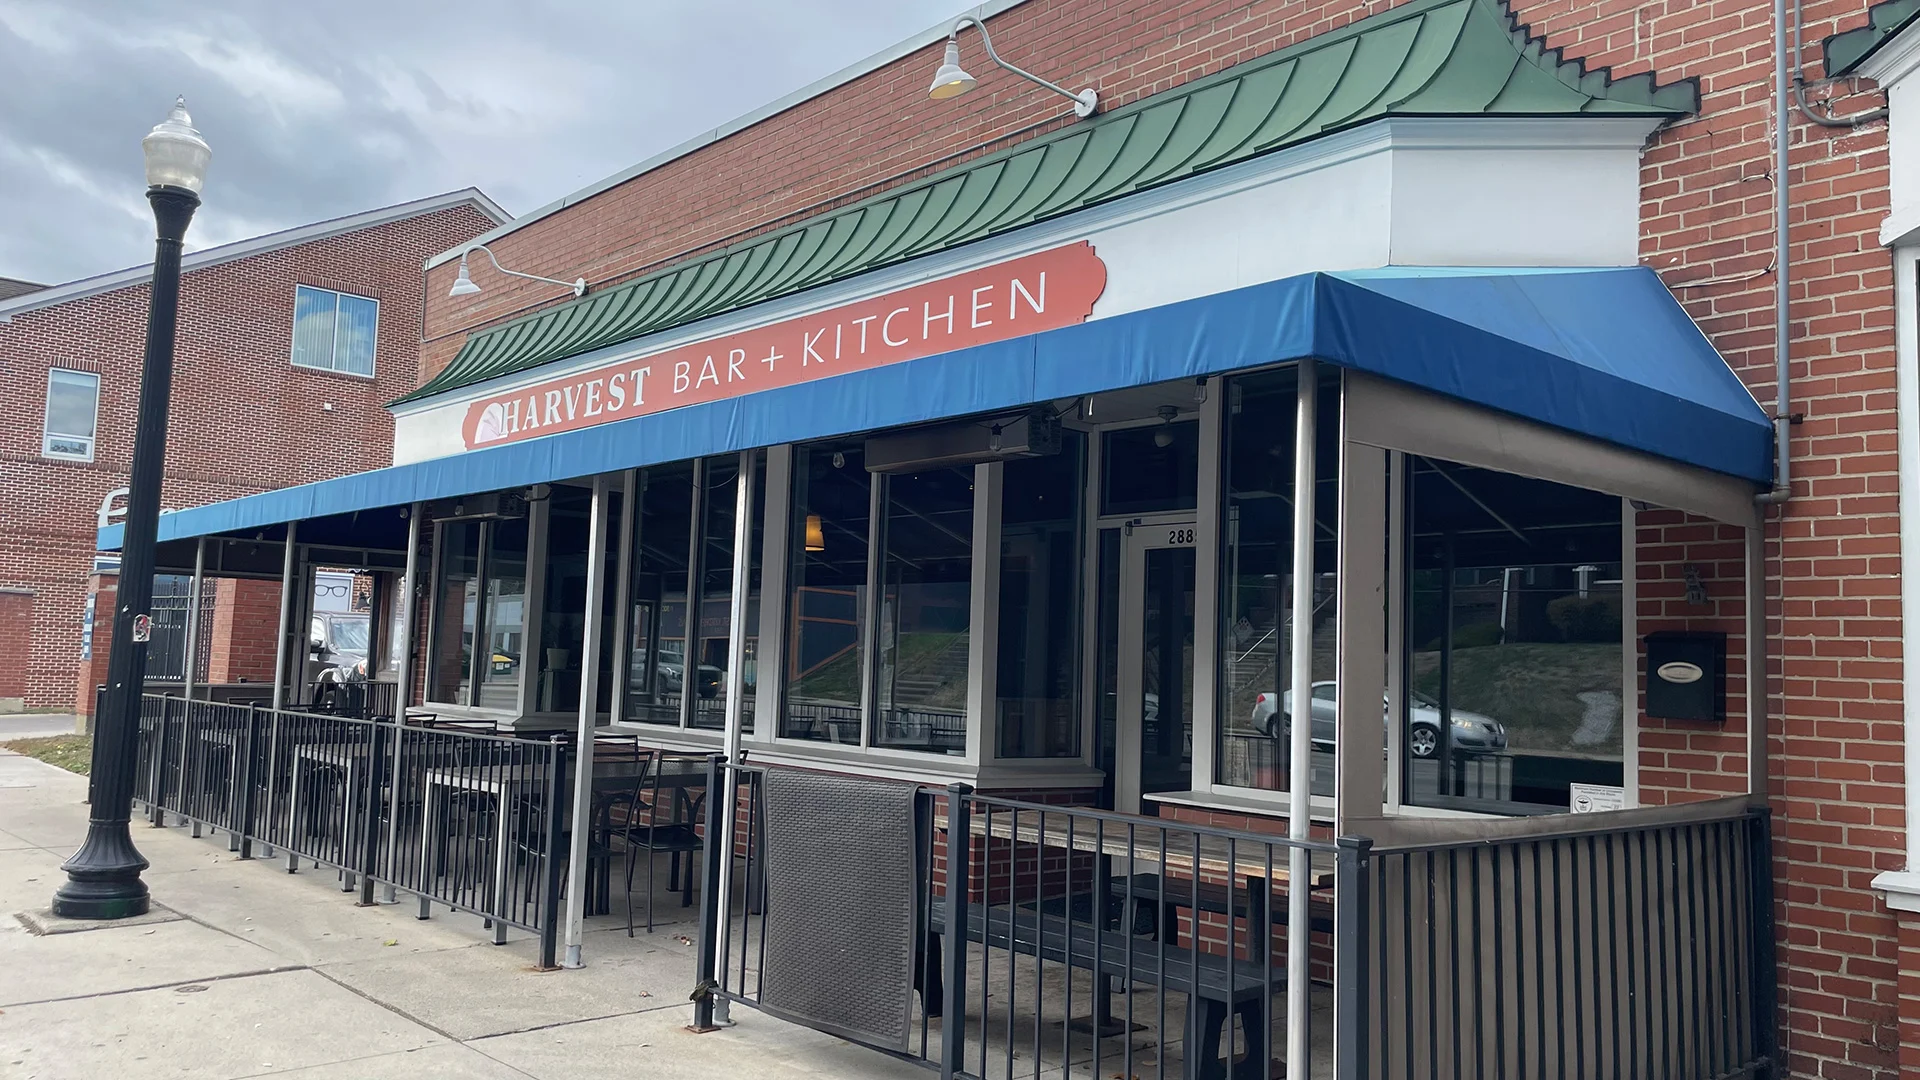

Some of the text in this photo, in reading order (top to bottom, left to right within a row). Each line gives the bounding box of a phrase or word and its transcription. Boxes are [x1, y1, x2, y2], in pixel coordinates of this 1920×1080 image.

[500, 367, 651, 437] HARVEST
[673, 348, 746, 394] BAR
[802, 271, 1047, 367] KITCHEN
[1168, 529, 1197, 544] 288
